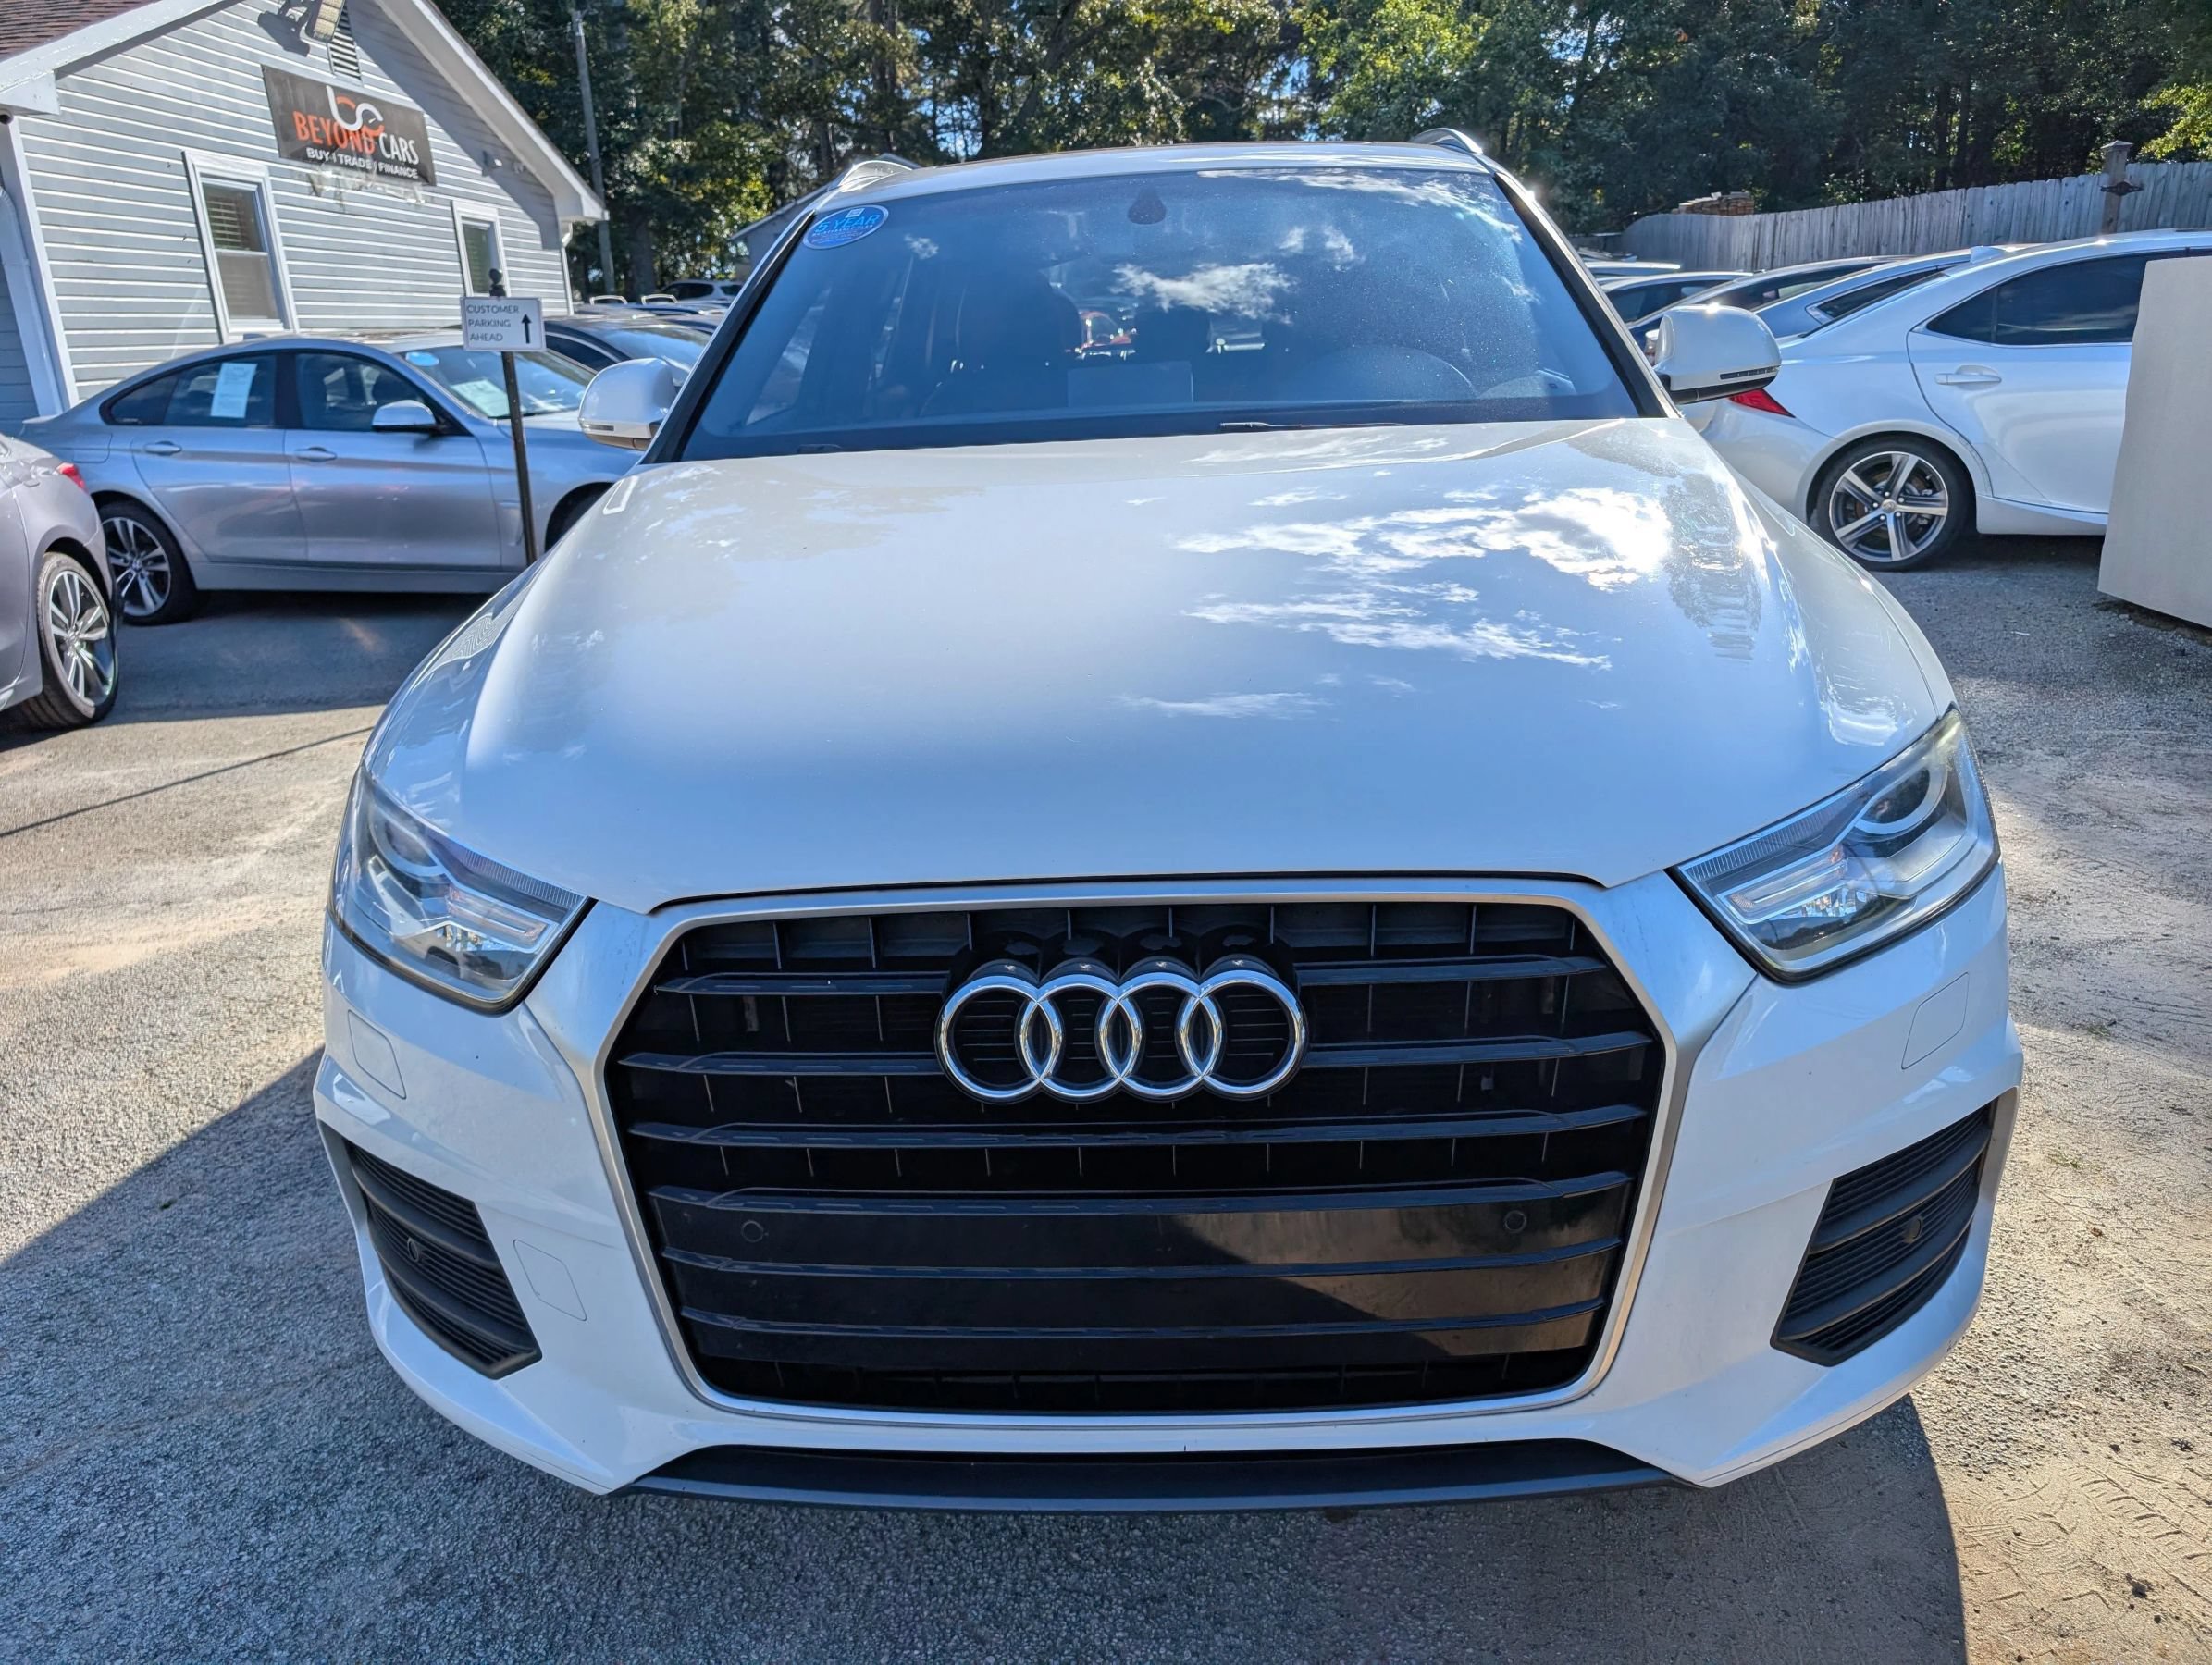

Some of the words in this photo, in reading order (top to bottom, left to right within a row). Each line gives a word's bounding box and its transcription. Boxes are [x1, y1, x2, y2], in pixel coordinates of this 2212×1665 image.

[292, 110, 377, 155] BEYOND
[378, 132, 420, 165] CARS
[305, 147, 330, 162] BUY
[337, 153, 373, 170] TRADE
[377, 162, 419, 179] FINANCE
[814, 221, 829, 233] 5
[834, 214, 881, 229] YEAR
[466, 304, 520, 314] CUSTOMER
[467, 318, 512, 328] PARKING
[469, 332, 504, 342] AHEAD
